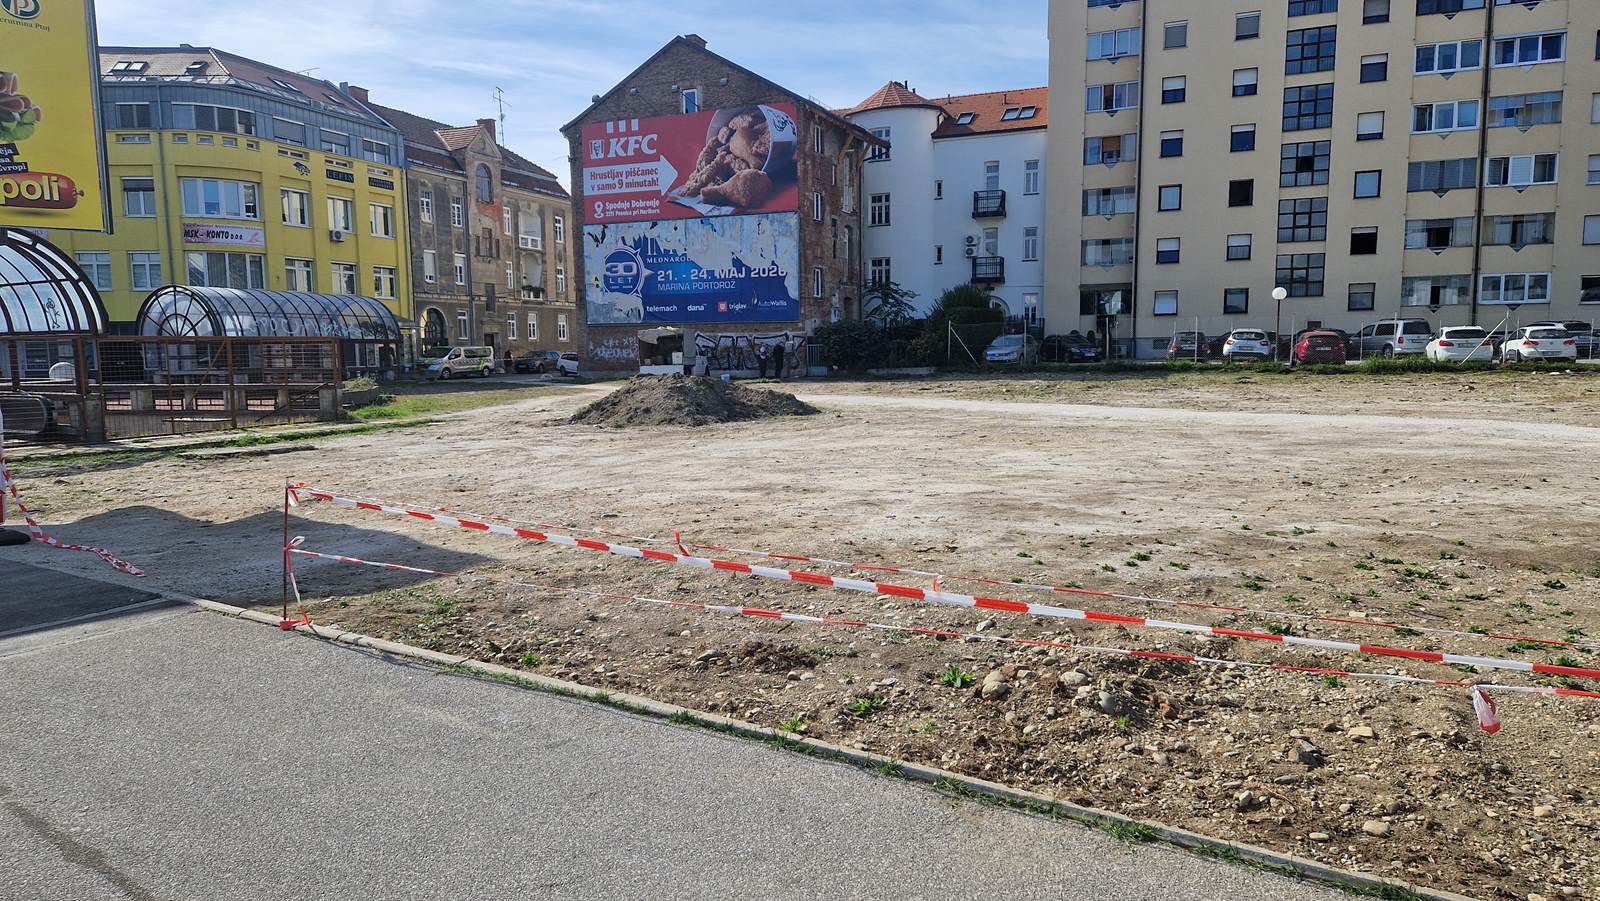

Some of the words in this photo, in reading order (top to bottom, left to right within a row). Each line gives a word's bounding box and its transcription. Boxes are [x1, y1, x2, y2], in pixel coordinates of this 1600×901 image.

[607, 134, 658, 158] KFC
[590, 170, 624, 181] Hrustljav
[625, 167, 658, 178] piščanec
[0, 175, 60, 204] poli
[599, 182, 617, 191] samo
[617, 179, 624, 189] 9
[625, 178, 659, 188] minutah!
[606, 200, 630, 210] Spodnje
[631, 197, 660, 208] Dobrenje
[184, 229, 199, 238] MSK
[206, 230, 229, 239] KONTO
[657, 270, 678, 281] 21.
[690, 268, 711, 279] 24.
[715, 267, 746, 279] MAJ
[657, 282, 691, 292] MARINA
[646, 304, 678, 312] telemach
[687, 304, 705, 312] dana
[728, 303, 747, 311] triglav
